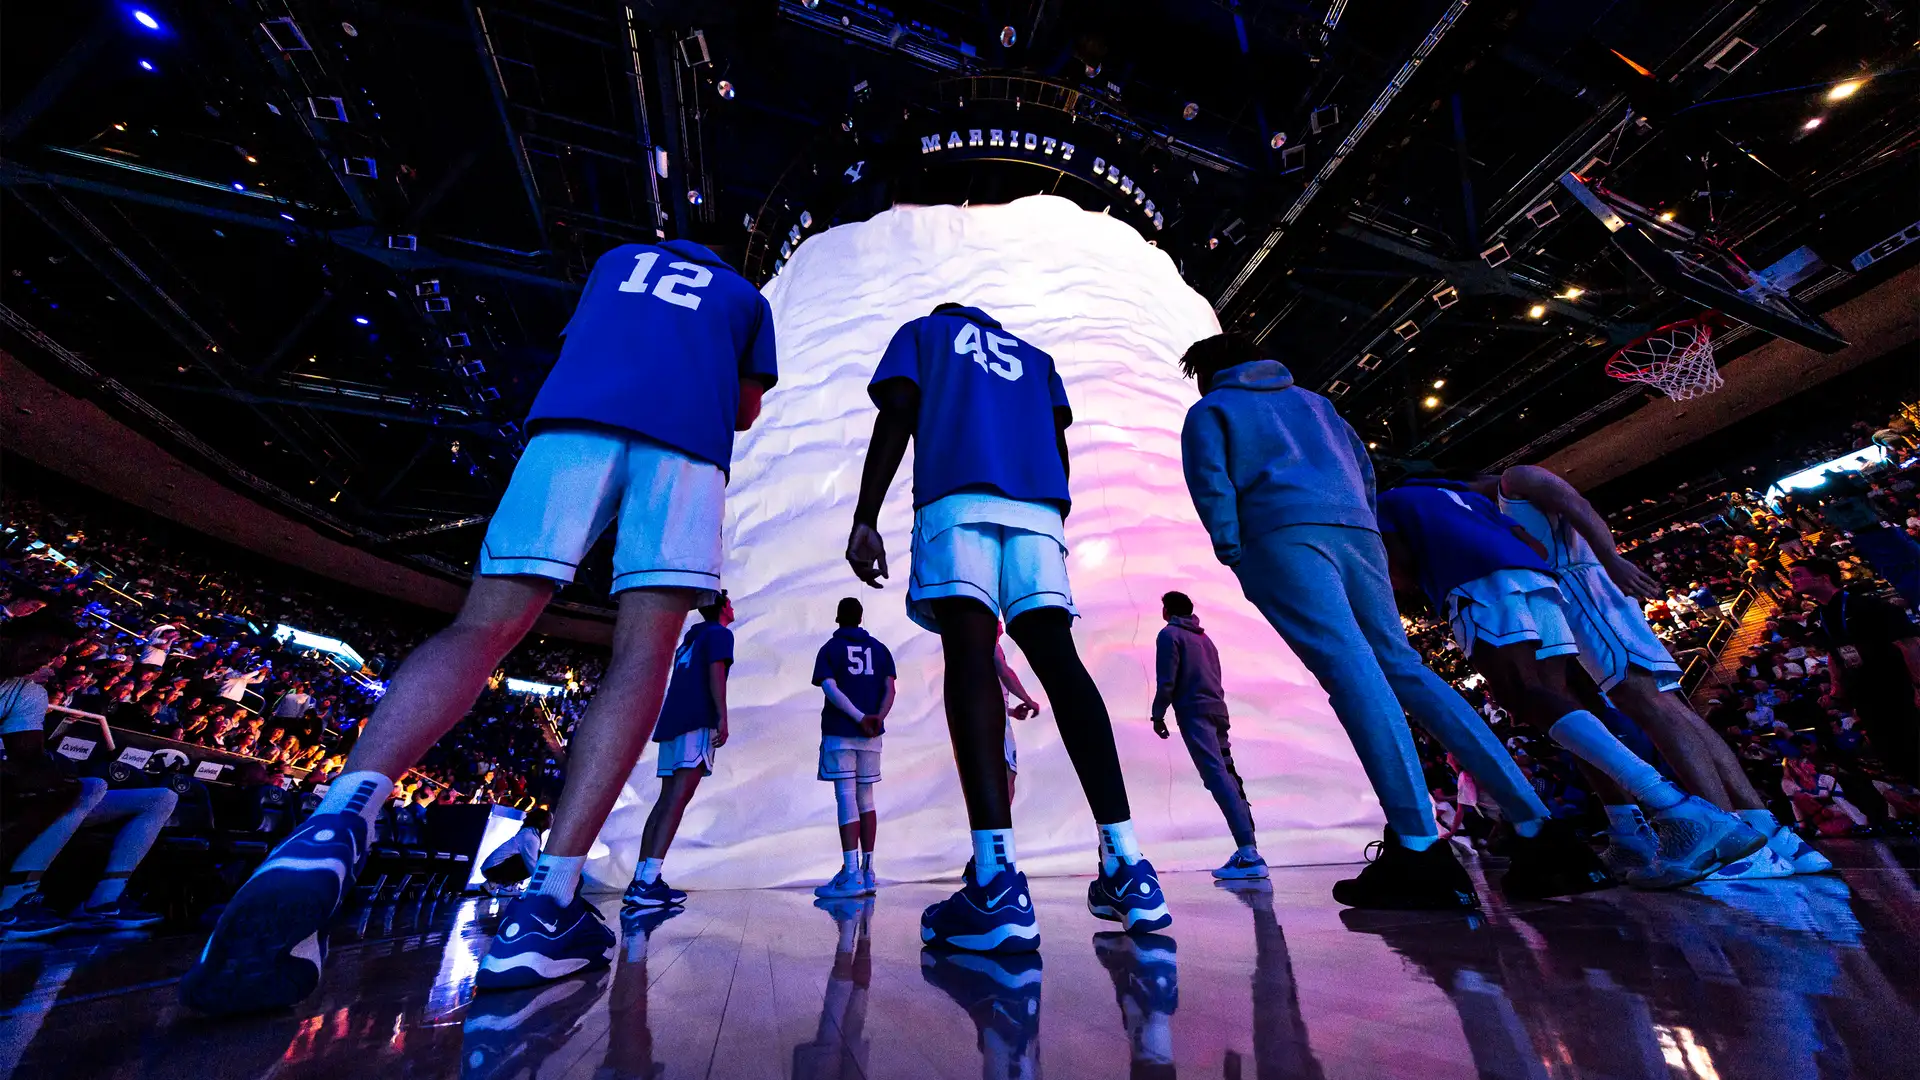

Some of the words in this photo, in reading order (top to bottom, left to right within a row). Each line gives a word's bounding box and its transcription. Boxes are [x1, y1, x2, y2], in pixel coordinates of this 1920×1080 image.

[844, 161, 865, 183] Y
[921, 129, 1075, 161] MARRIOTT
[1093, 156, 1164, 231] CENTER
[618, 251, 714, 311] 12
[954, 322, 1024, 381] 45
[847, 645, 874, 675] 51
